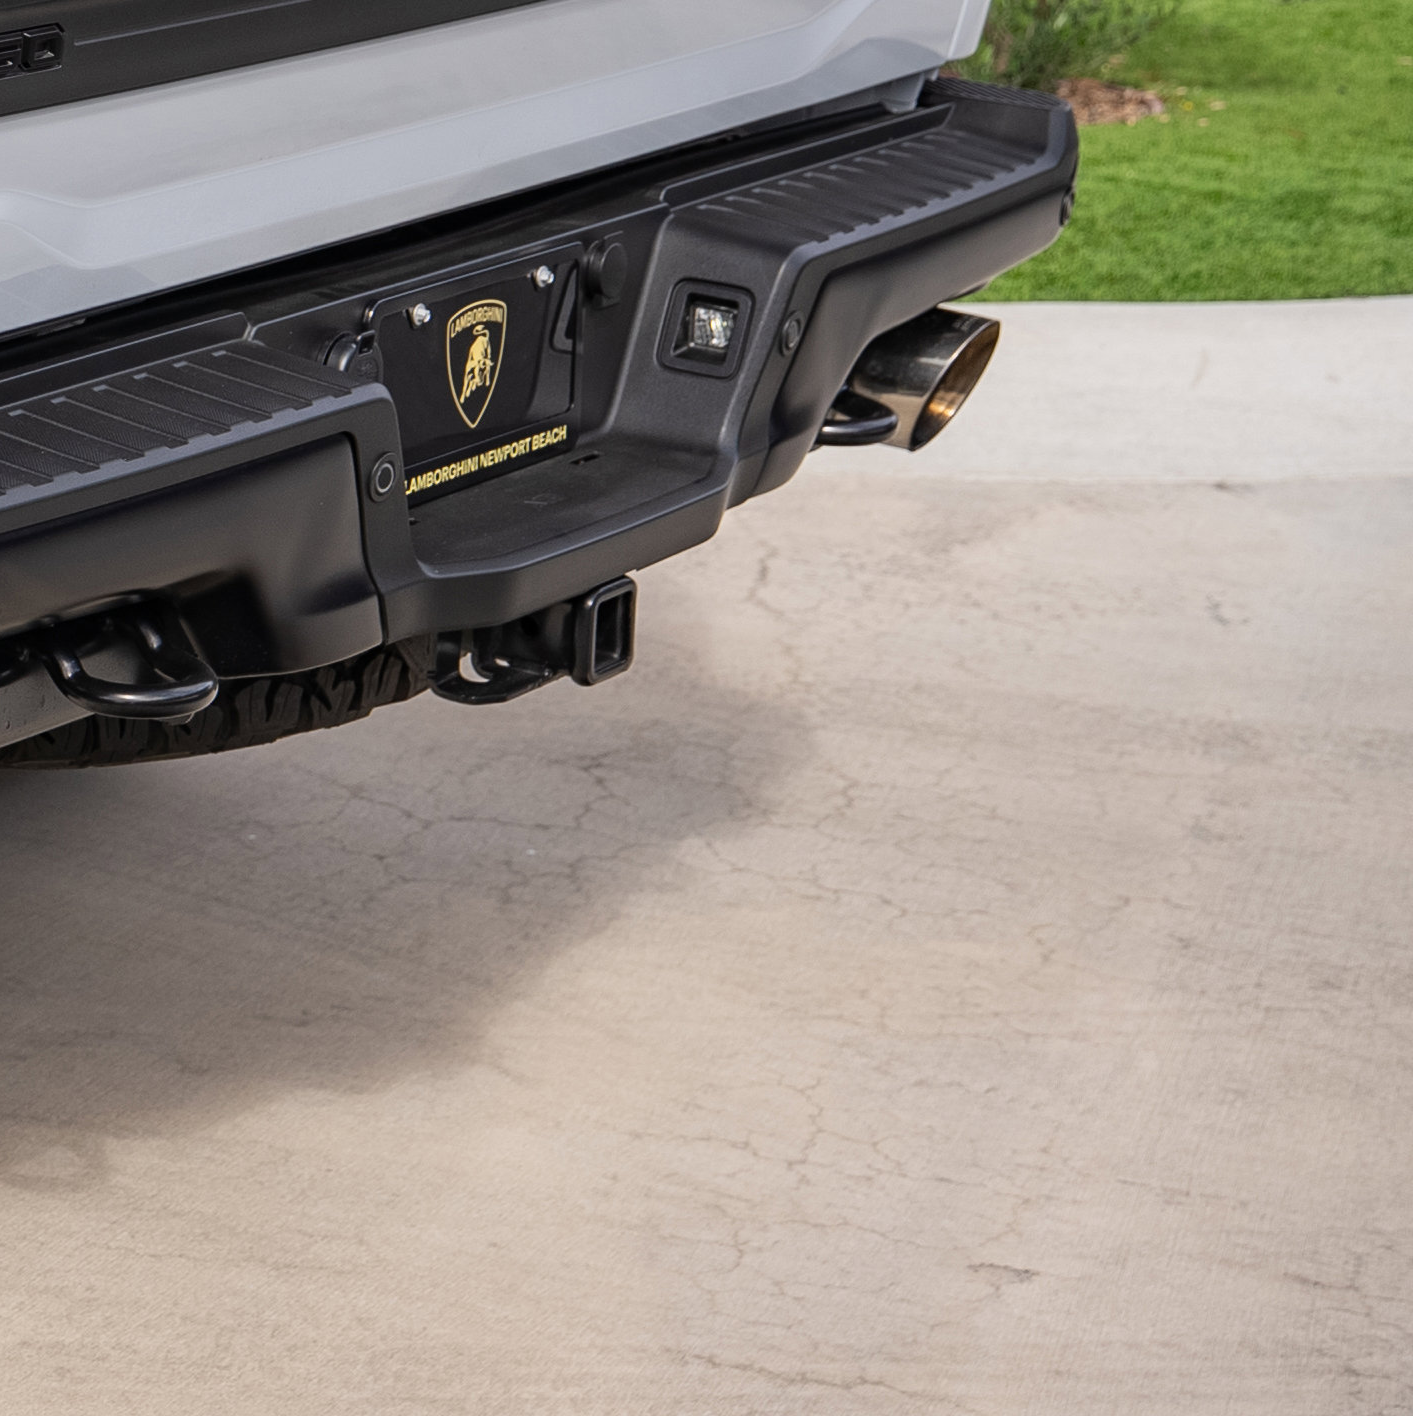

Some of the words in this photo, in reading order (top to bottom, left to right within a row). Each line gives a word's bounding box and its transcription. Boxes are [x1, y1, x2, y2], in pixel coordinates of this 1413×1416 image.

[451, 305, 503, 338] LAMBORGHINI
[404, 455, 479, 496] LAMBORGHINI
[479, 437, 531, 468] NEWPORT
[531, 424, 568, 451] BEACH
